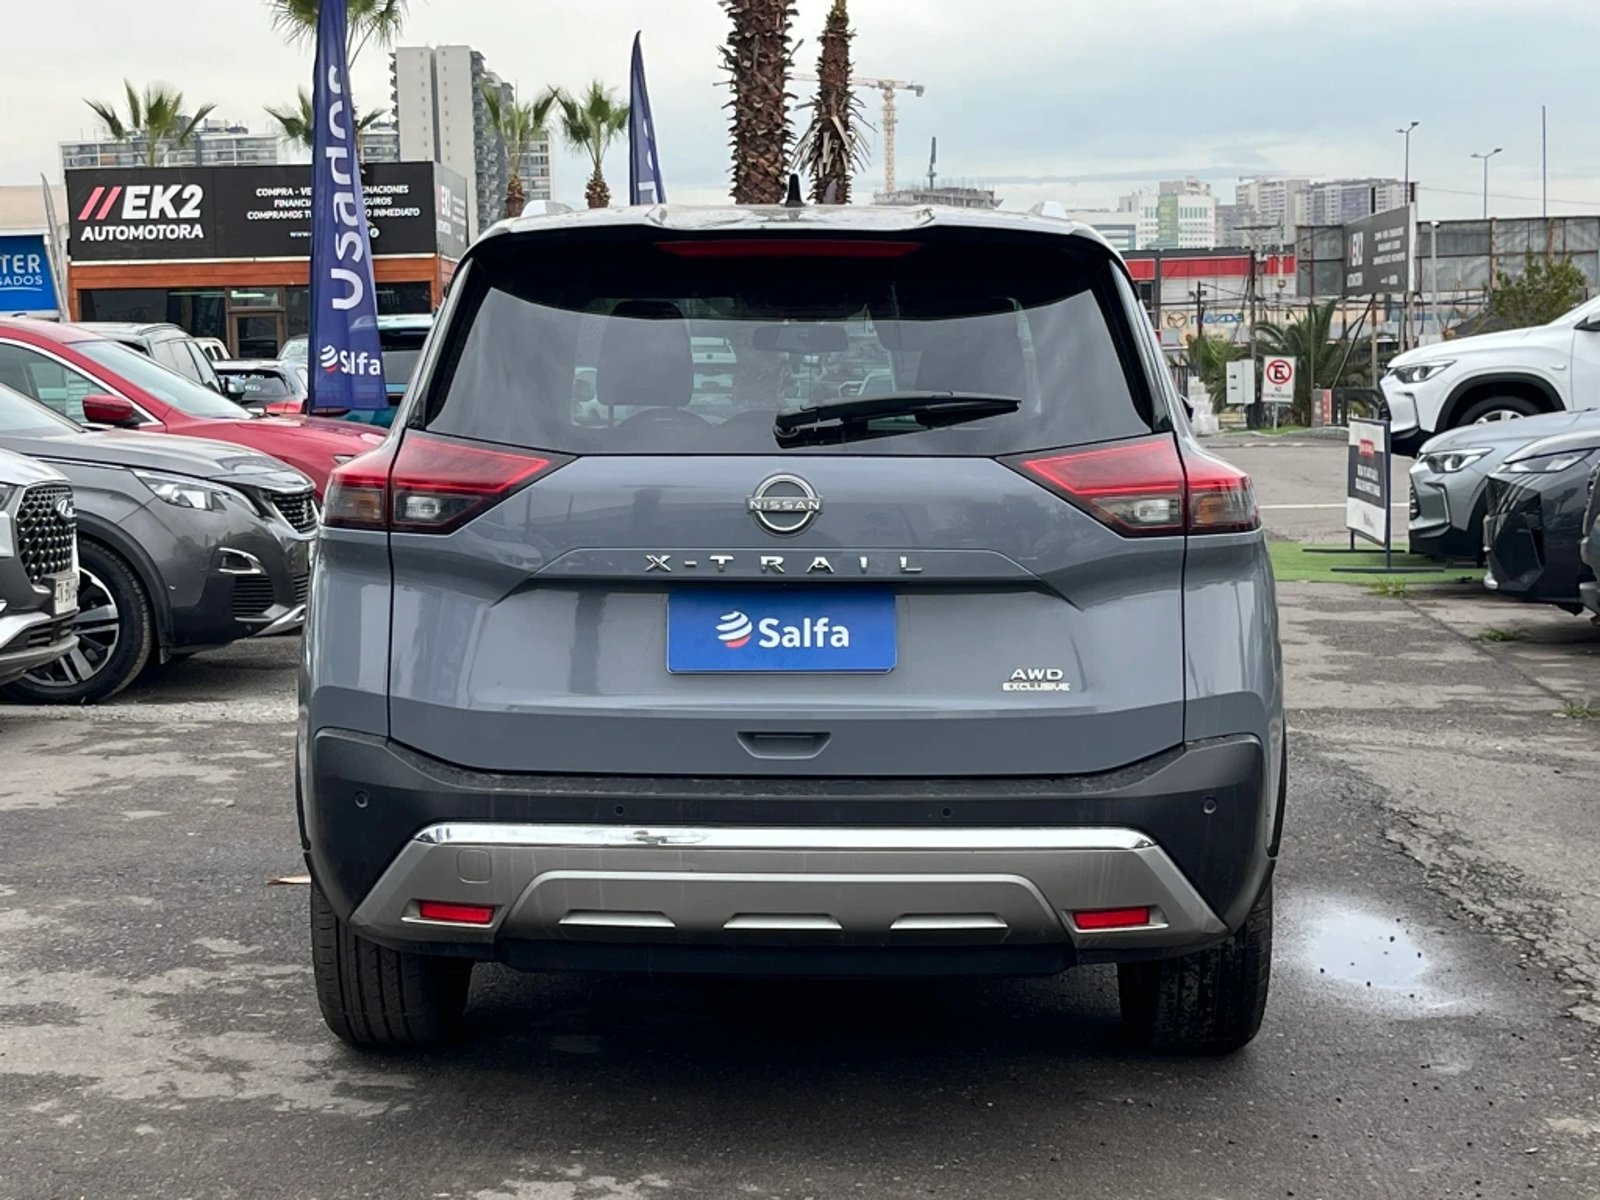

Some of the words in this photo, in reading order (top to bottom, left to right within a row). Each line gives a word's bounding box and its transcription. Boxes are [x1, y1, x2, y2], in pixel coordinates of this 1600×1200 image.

[255, 187, 294, 197] COMPRA
[247, 210, 303, 220] COMPRAMOS
[373, 207, 420, 217] INMEDIATO
[81, 224, 204, 241] AUTOMOTORA
[0, 275, 43, 286] ADOS
[340, 350, 381, 376] Slfa
[749, 500, 820, 510] NISSAN
[645, 554, 923, 573] X-TRAIL
[758, 617, 850, 648] Salfa
[1010, 668, 1064, 680] AWD
[1002, 682, 1070, 691] EXCLUSIVE
